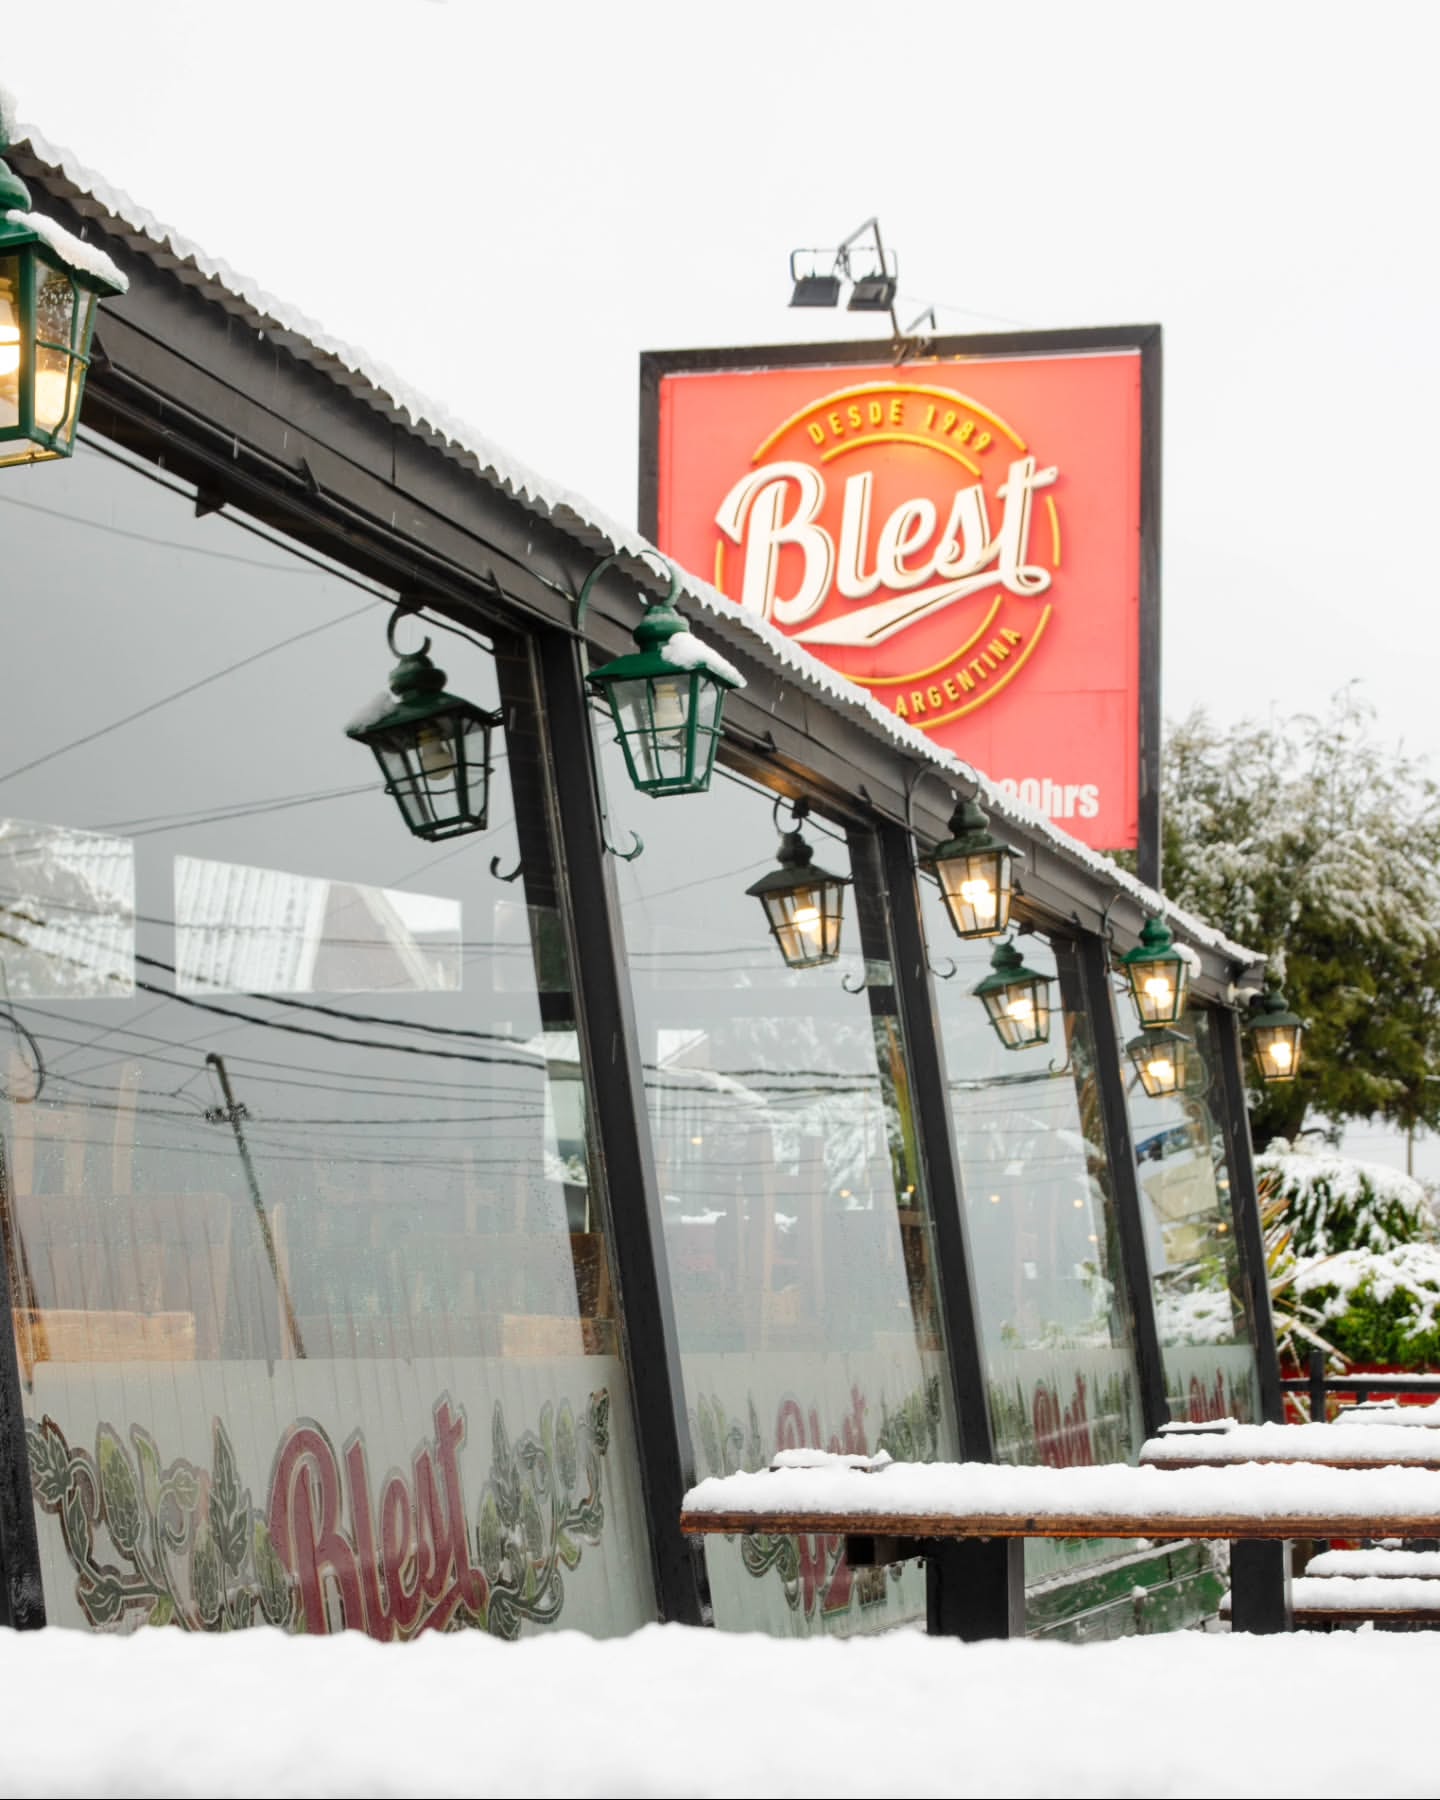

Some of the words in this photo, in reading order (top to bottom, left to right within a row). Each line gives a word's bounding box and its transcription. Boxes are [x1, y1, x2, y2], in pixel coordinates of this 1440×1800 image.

[807, 399, 903, 445] DESDE
[925, 403, 993, 453] 1989
[714, 455, 1059, 646] Blest
[895, 627, 1022, 718] ARGENTINA
